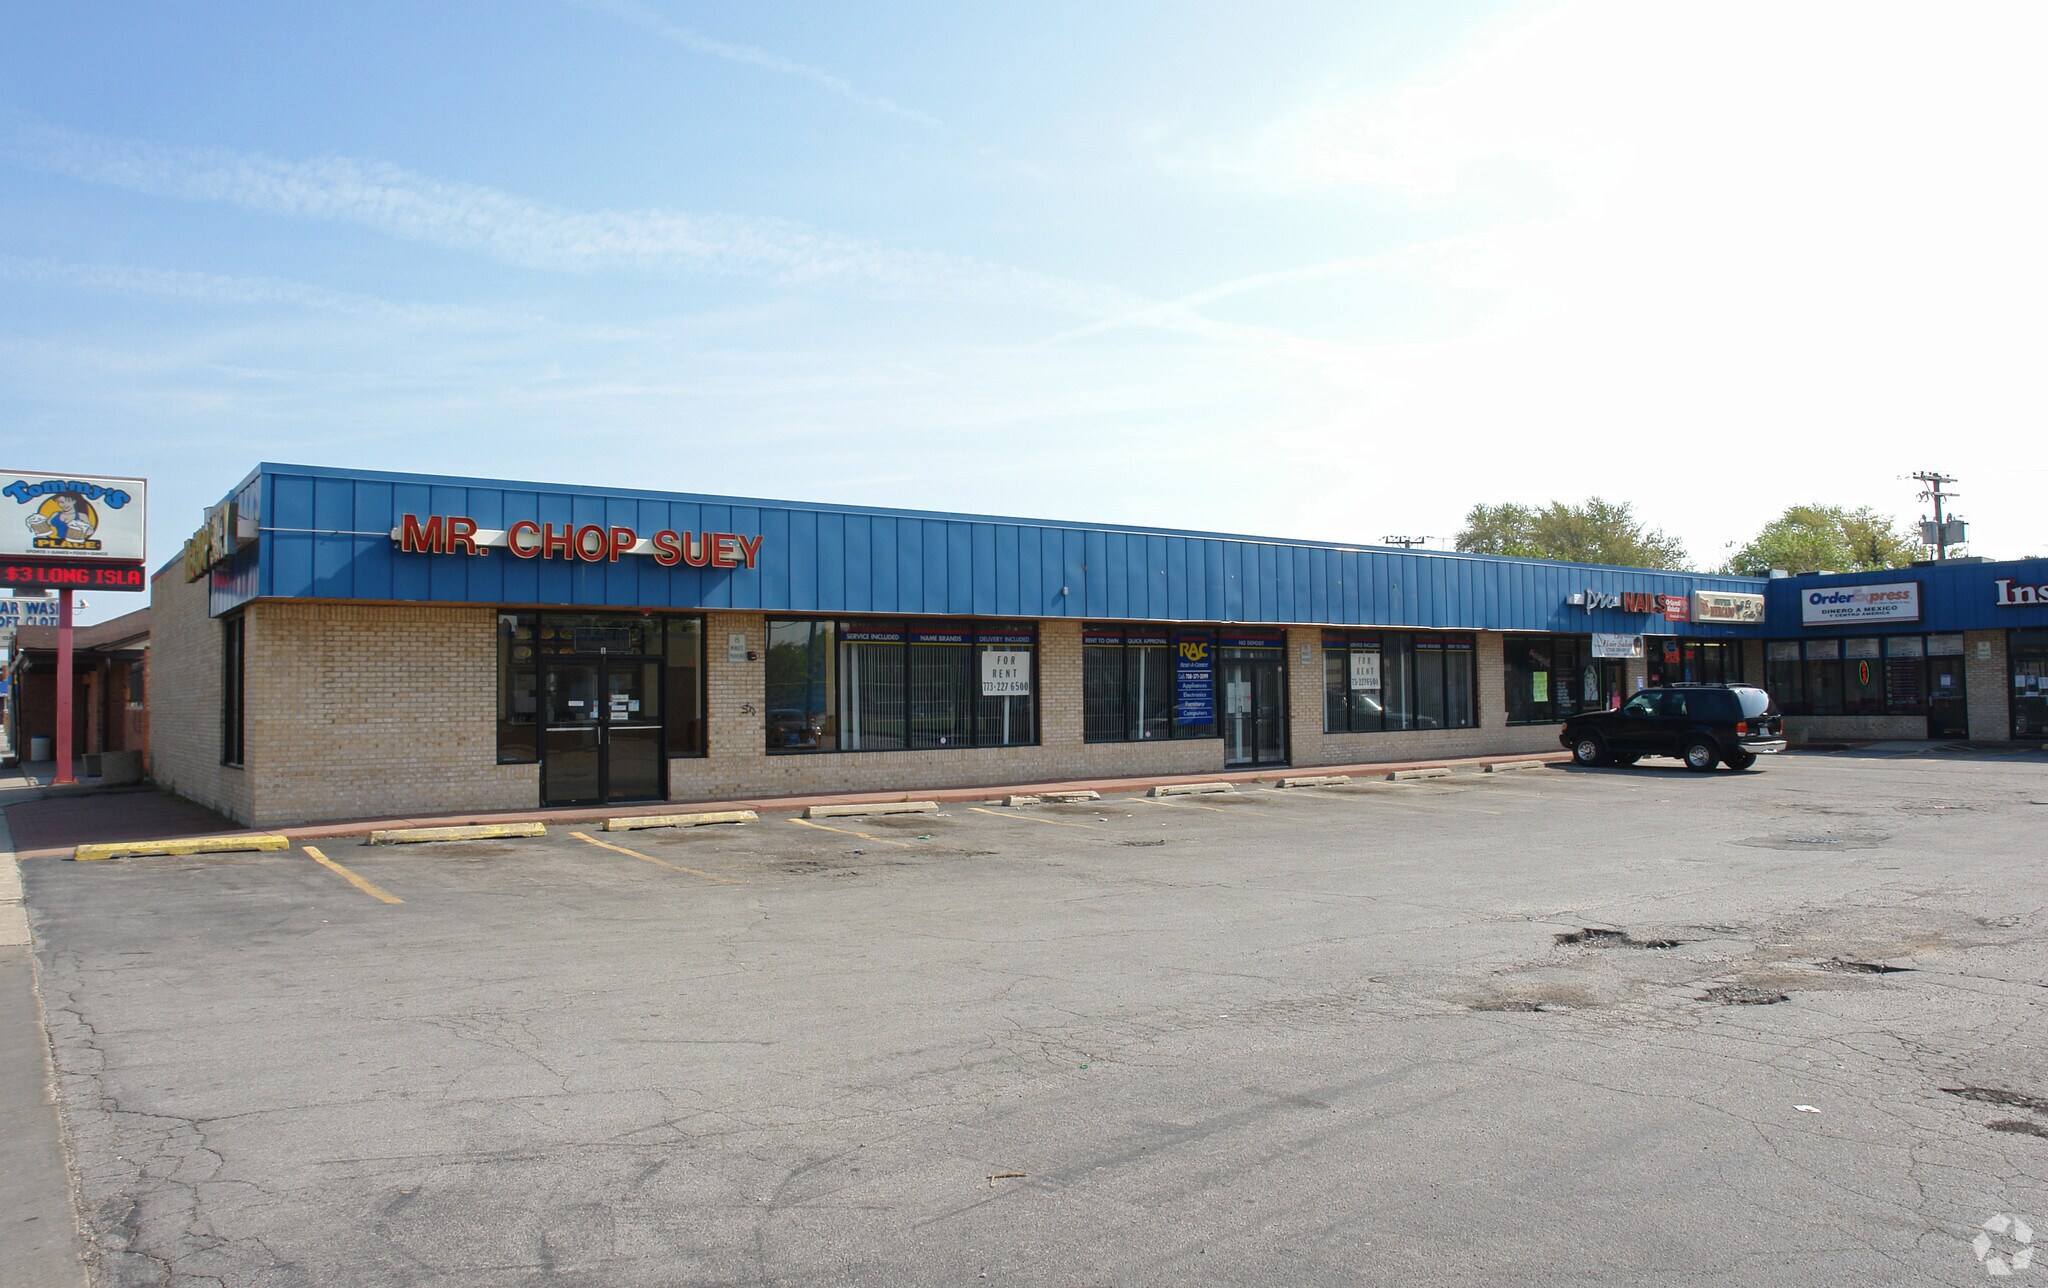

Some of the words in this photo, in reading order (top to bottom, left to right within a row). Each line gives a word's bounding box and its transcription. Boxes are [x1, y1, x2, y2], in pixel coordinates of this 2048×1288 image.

[2, 480, 131, 509] Tommy's
[36, 540, 97, 549] PLACE
[401, 513, 489, 556] MR.
[507, 519, 637, 563] CHOP
[652, 529, 764, 569] SUEY
[3, 566, 33, 582] $3
[37, 567, 90, 583] LONG
[95, 569, 141, 585] ISLA
[25, 602, 59, 615] WAS
[1624, 591, 1667, 613] NAILS
[26, 616, 59, 626] CLOT
[1179, 642, 1208, 661] RAC
[997, 656, 1016, 665] FOR
[992, 669, 1017, 678] RENT
[1010, 682, 1029, 691] 6500
